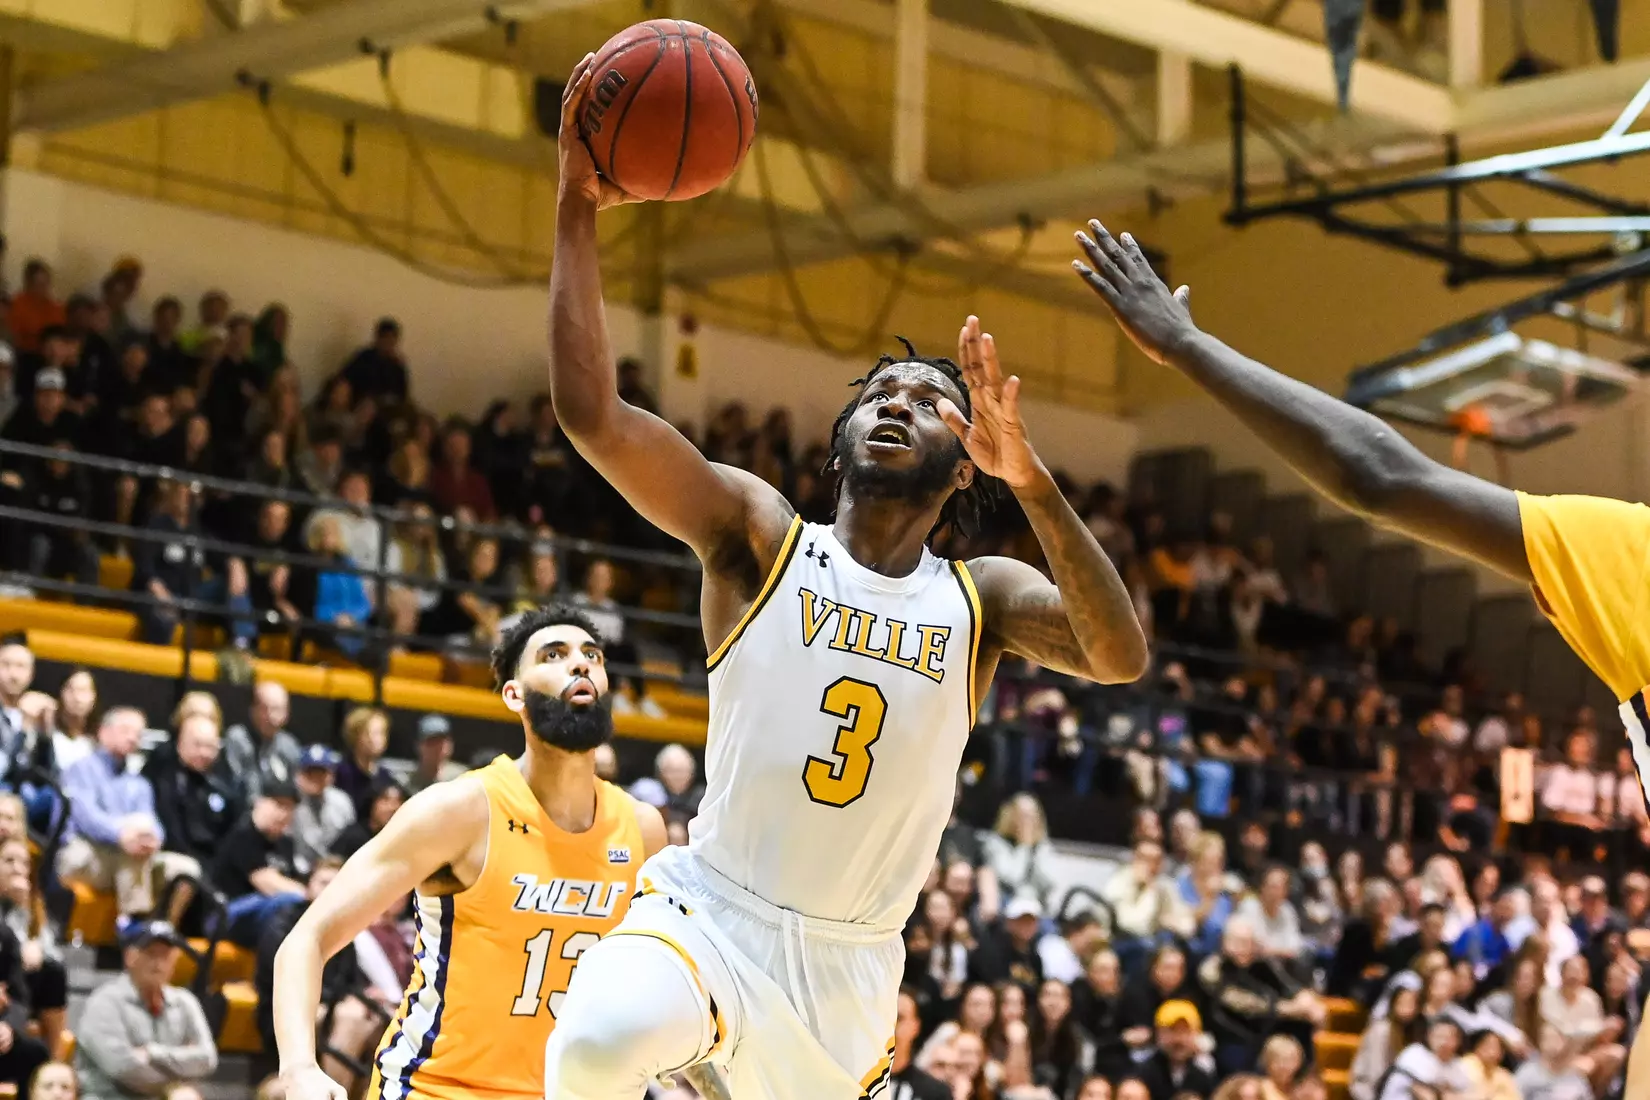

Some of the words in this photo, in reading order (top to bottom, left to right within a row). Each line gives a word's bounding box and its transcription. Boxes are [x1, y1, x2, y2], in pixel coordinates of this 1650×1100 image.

[798, 586, 951, 684] VILLE
[802, 675, 888, 808] 3
[511, 873, 628, 918] WCU
